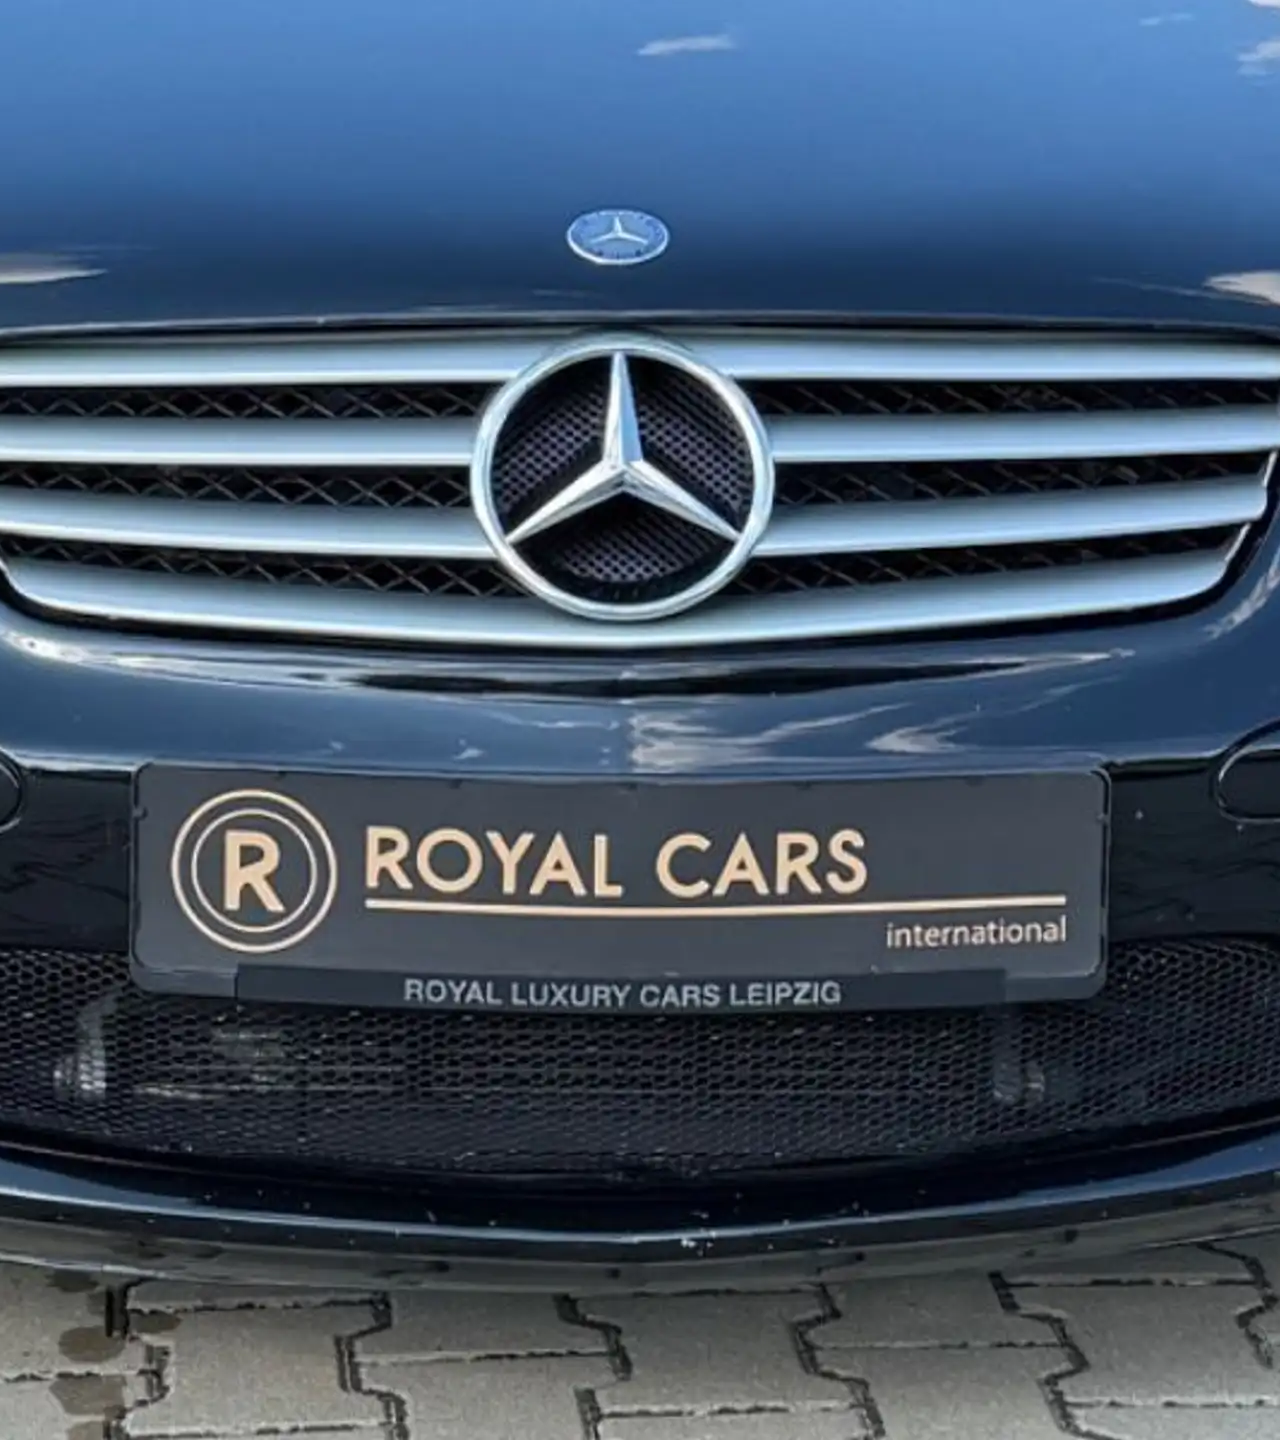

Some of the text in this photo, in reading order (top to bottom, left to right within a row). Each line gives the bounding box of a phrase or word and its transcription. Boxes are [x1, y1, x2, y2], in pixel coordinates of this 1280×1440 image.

[223, 827, 286, 913] R
[364, 824, 868, 899] ROYAL CARS
[885, 914, 1067, 949] international
[402, 977, 842, 1008] ROYAL LUXURY CARS LEIPZIG
